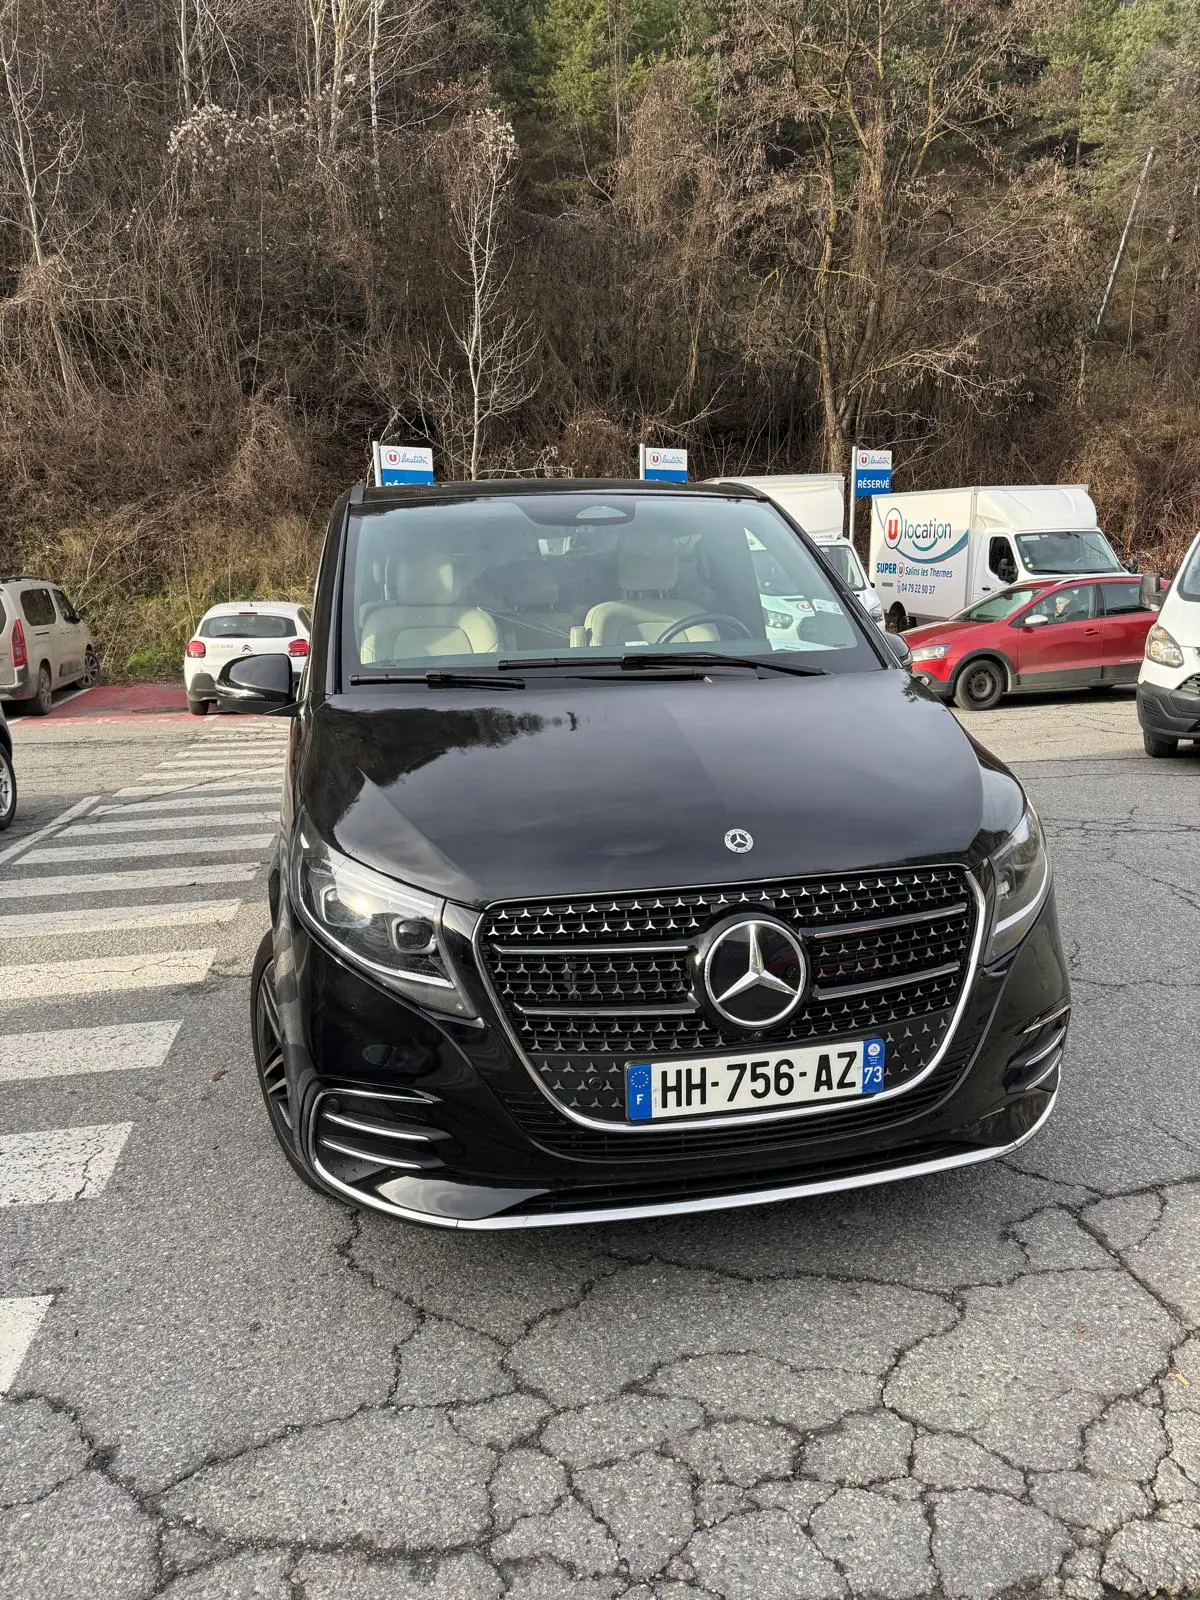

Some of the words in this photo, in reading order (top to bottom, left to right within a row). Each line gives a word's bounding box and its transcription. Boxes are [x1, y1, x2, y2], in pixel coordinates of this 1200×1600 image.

[857, 477, 890, 489] RÉSERVÉ
[888, 519, 899, 541] U
[904, 518, 952, 540] location
[876, 562, 897, 575] SUPER
[905, 566, 920, 576] Salins
[920, 567, 929, 577] les
[930, 567, 953, 578] Thermes
[636, 1093, 644, 1105] F
[661, 1050, 857, 1109] HH-756-AZ
[863, 1065, 883, 1085] 73
